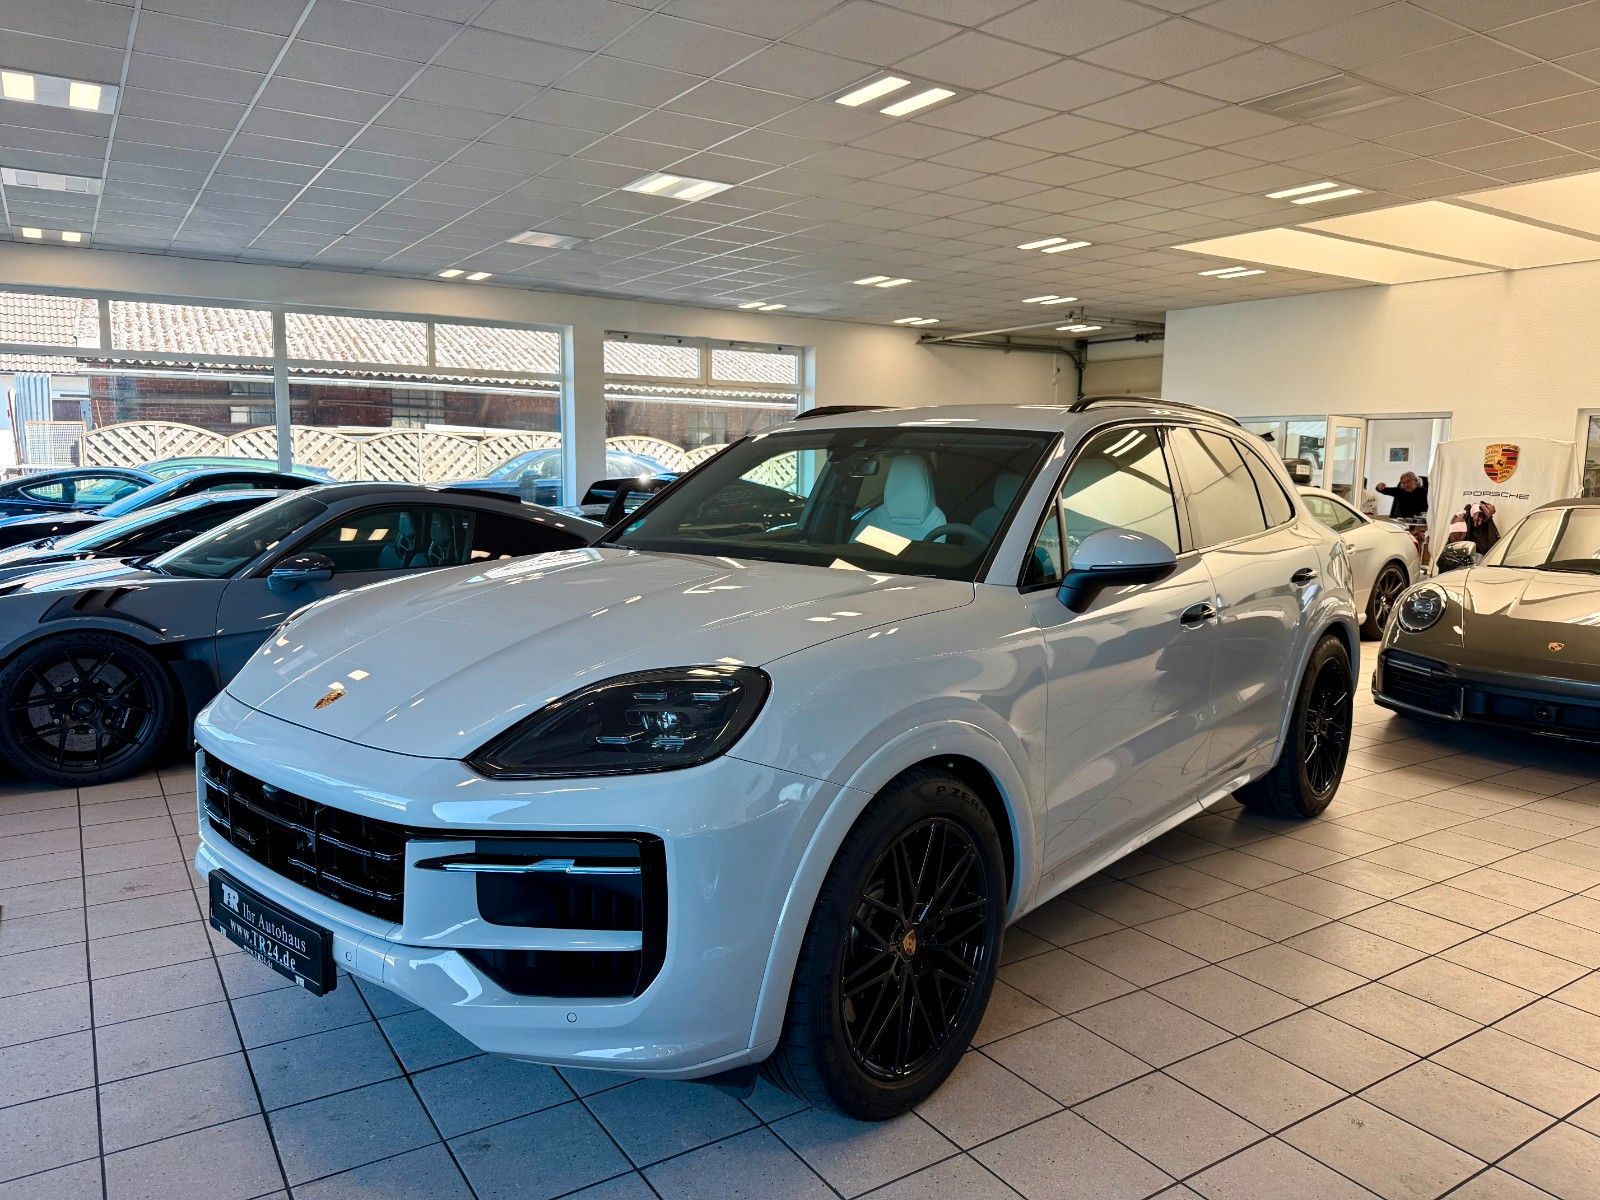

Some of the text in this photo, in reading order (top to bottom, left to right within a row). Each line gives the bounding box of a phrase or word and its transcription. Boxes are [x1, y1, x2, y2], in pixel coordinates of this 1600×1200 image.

[1463, 491, 1529, 500] PORSCHE
[229, 918, 296, 971] www.TR24.de
[242, 902, 255, 924] Ihr
[258, 914, 306, 953] Autohaus
